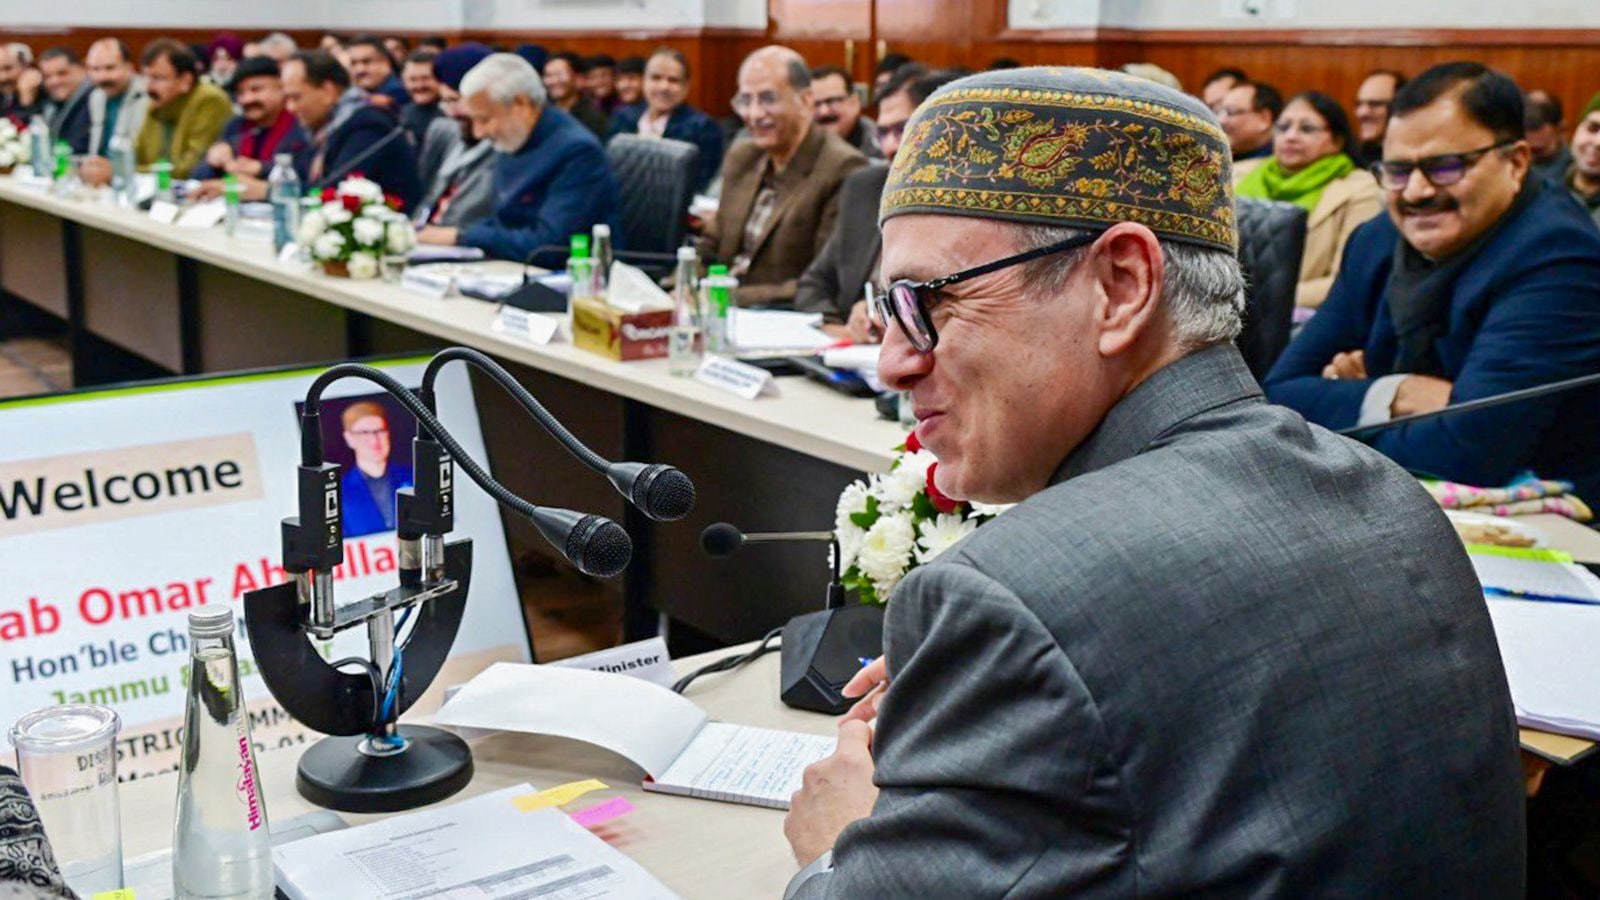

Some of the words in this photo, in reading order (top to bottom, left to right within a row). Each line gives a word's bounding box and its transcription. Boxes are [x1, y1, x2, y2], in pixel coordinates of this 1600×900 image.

[0, 459, 242, 520] Welcome
[79, 577, 213, 624] Omar
[237, 735, 262, 831] Himalayan
